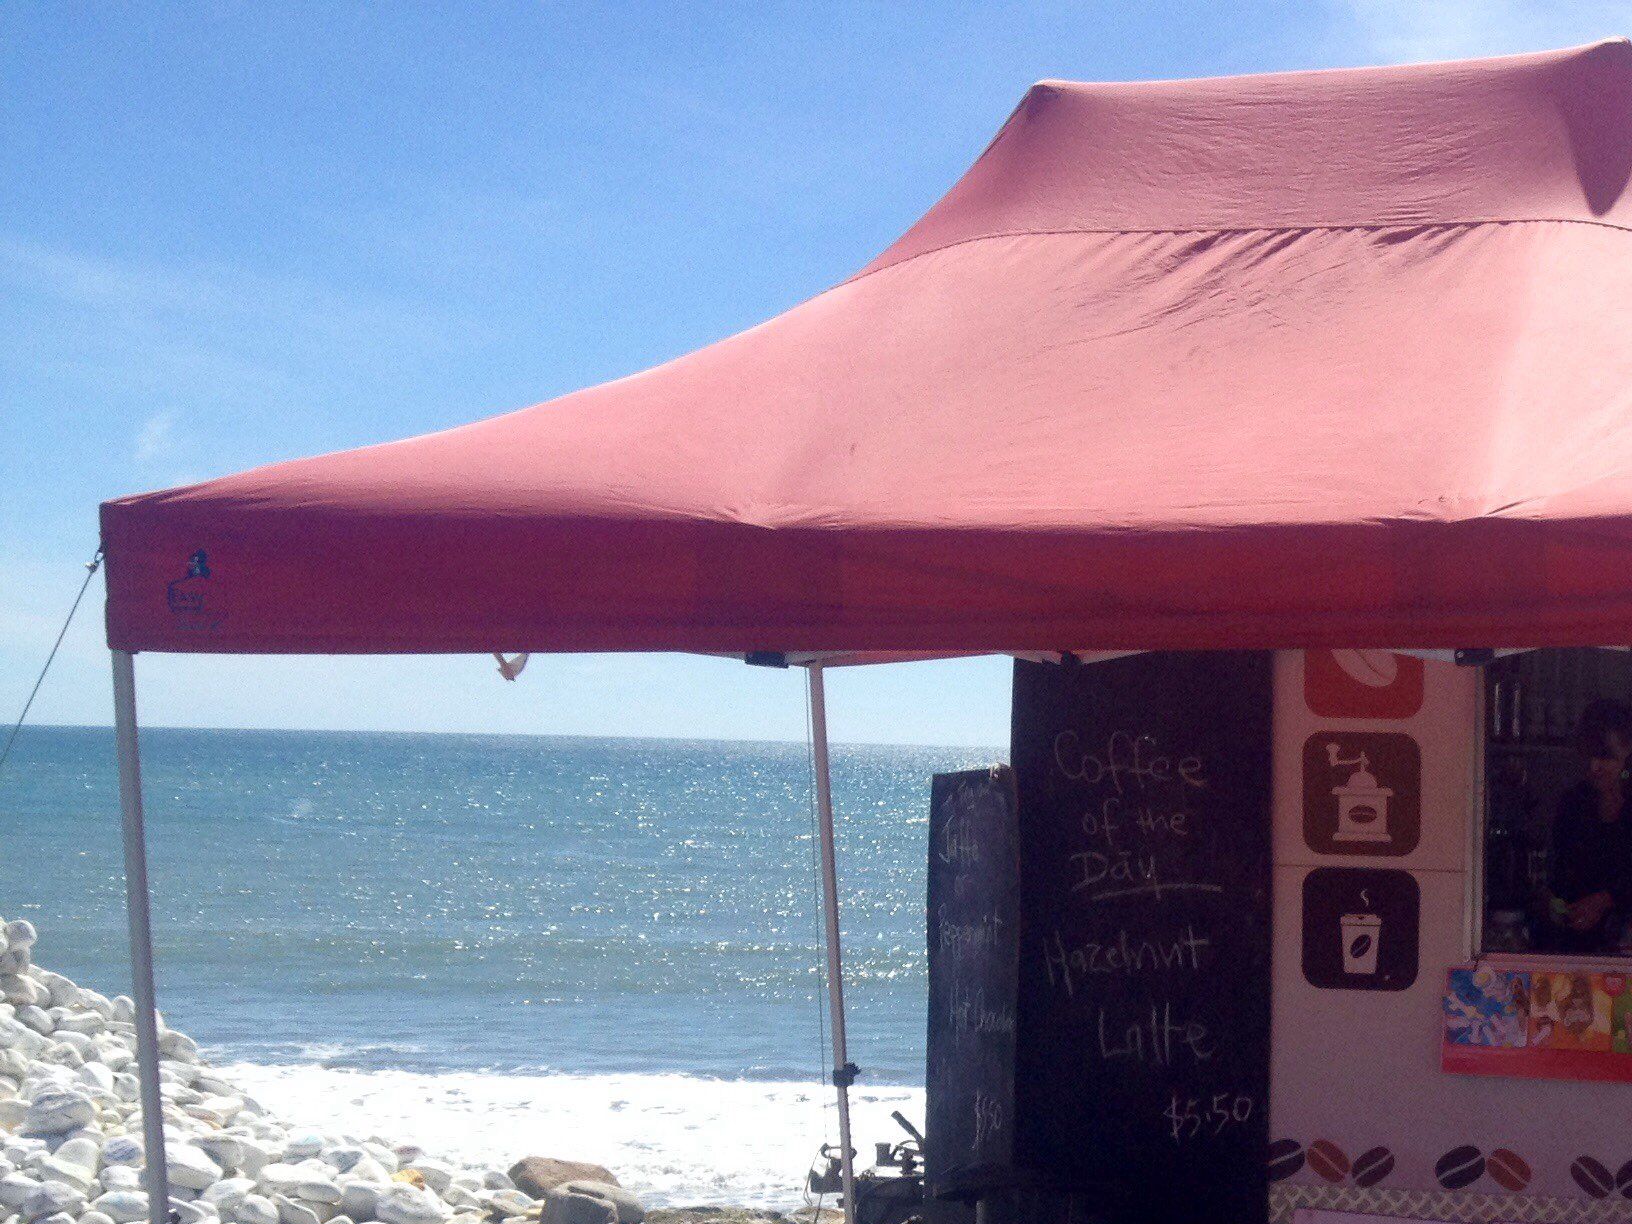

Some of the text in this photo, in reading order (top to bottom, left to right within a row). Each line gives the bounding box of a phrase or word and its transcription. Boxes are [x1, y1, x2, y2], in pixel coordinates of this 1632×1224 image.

[1054, 730, 1206, 794] Coffee
[1083, 800, 1188, 846] of the
[1070, 849, 1158, 899] Day
[1043, 927, 1208, 998] Hazelnut
[1099, 1002, 1216, 1064] Latte
[1162, 1096, 1252, 1147] $5.50
